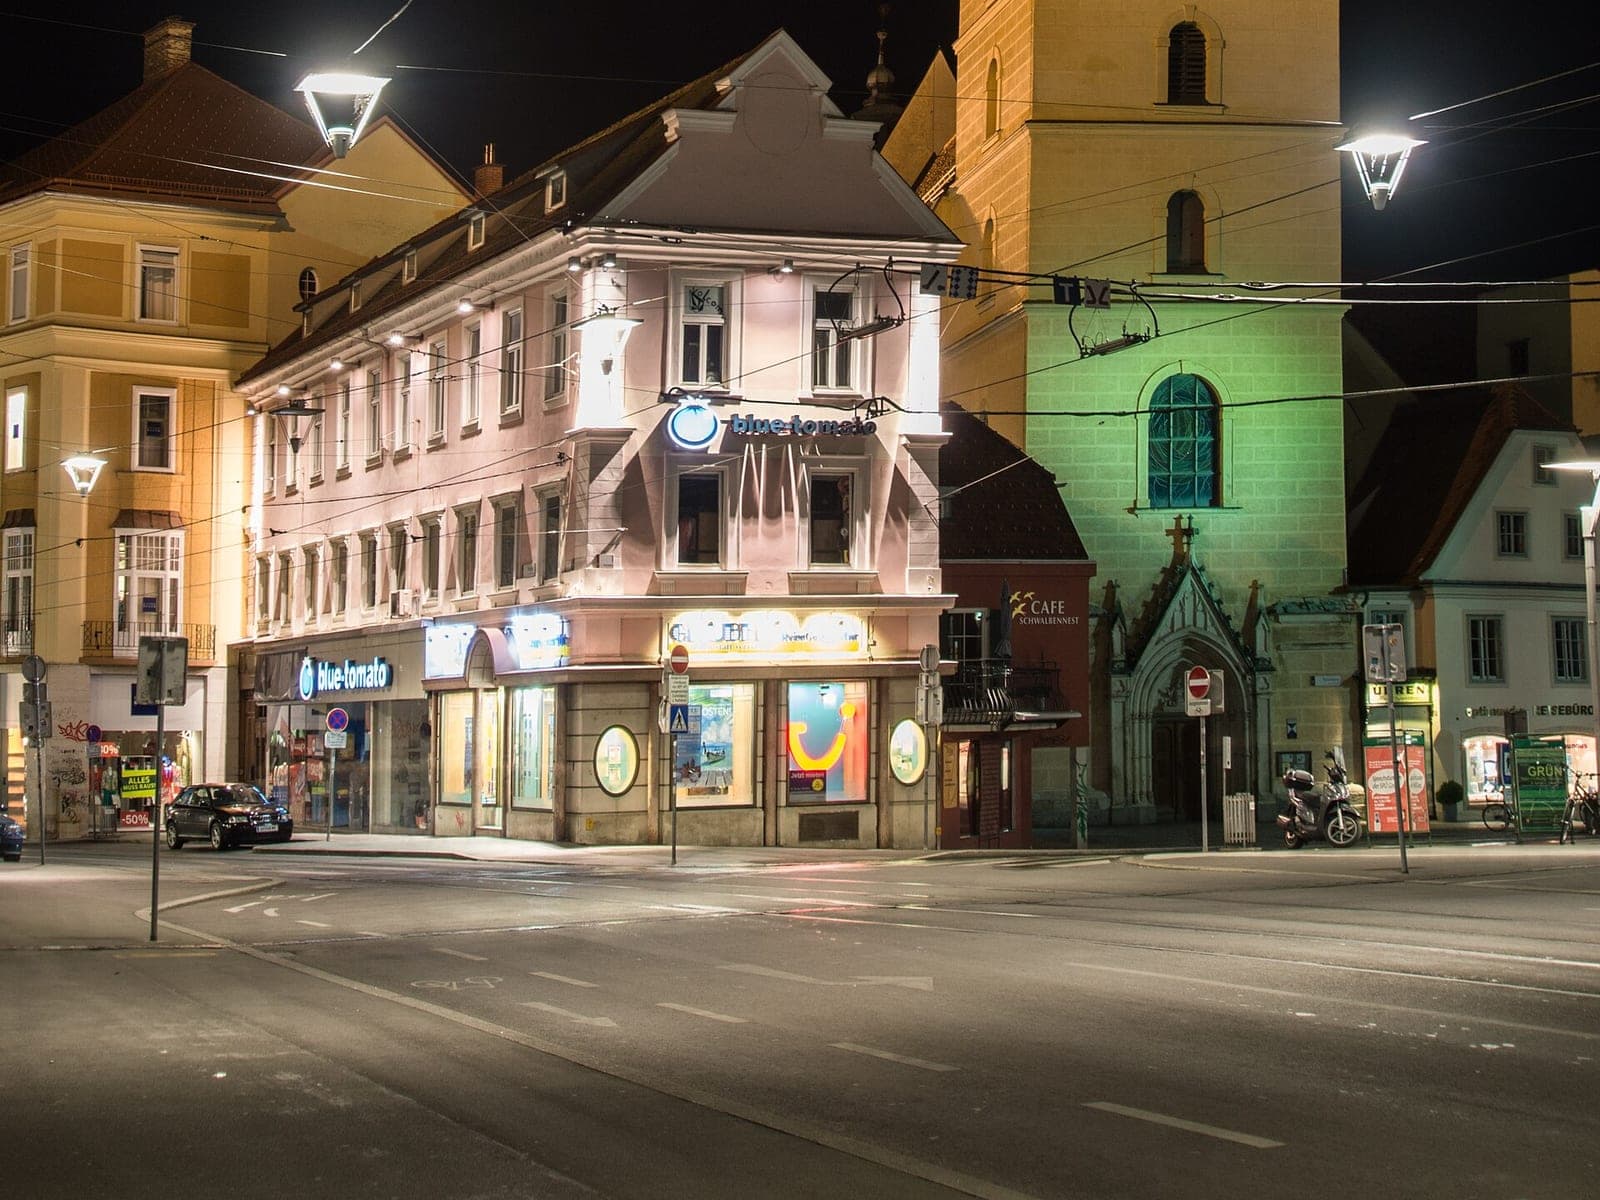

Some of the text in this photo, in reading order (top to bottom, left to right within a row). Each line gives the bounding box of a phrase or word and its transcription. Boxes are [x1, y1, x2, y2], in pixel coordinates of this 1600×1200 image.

[1058, 282, 1074, 303] T
[730, 413, 877, 435] blue-tomato
[1030, 600, 1065, 615] CAFE
[1019, 616, 1080, 625] SCHWALBENNEST
[317, 656, 388, 692] blue-tomato
[1527, 764, 1563, 777] GRÜN
[128, 776, 150, 785] ALLES
[121, 814, 149, 825] -50%
